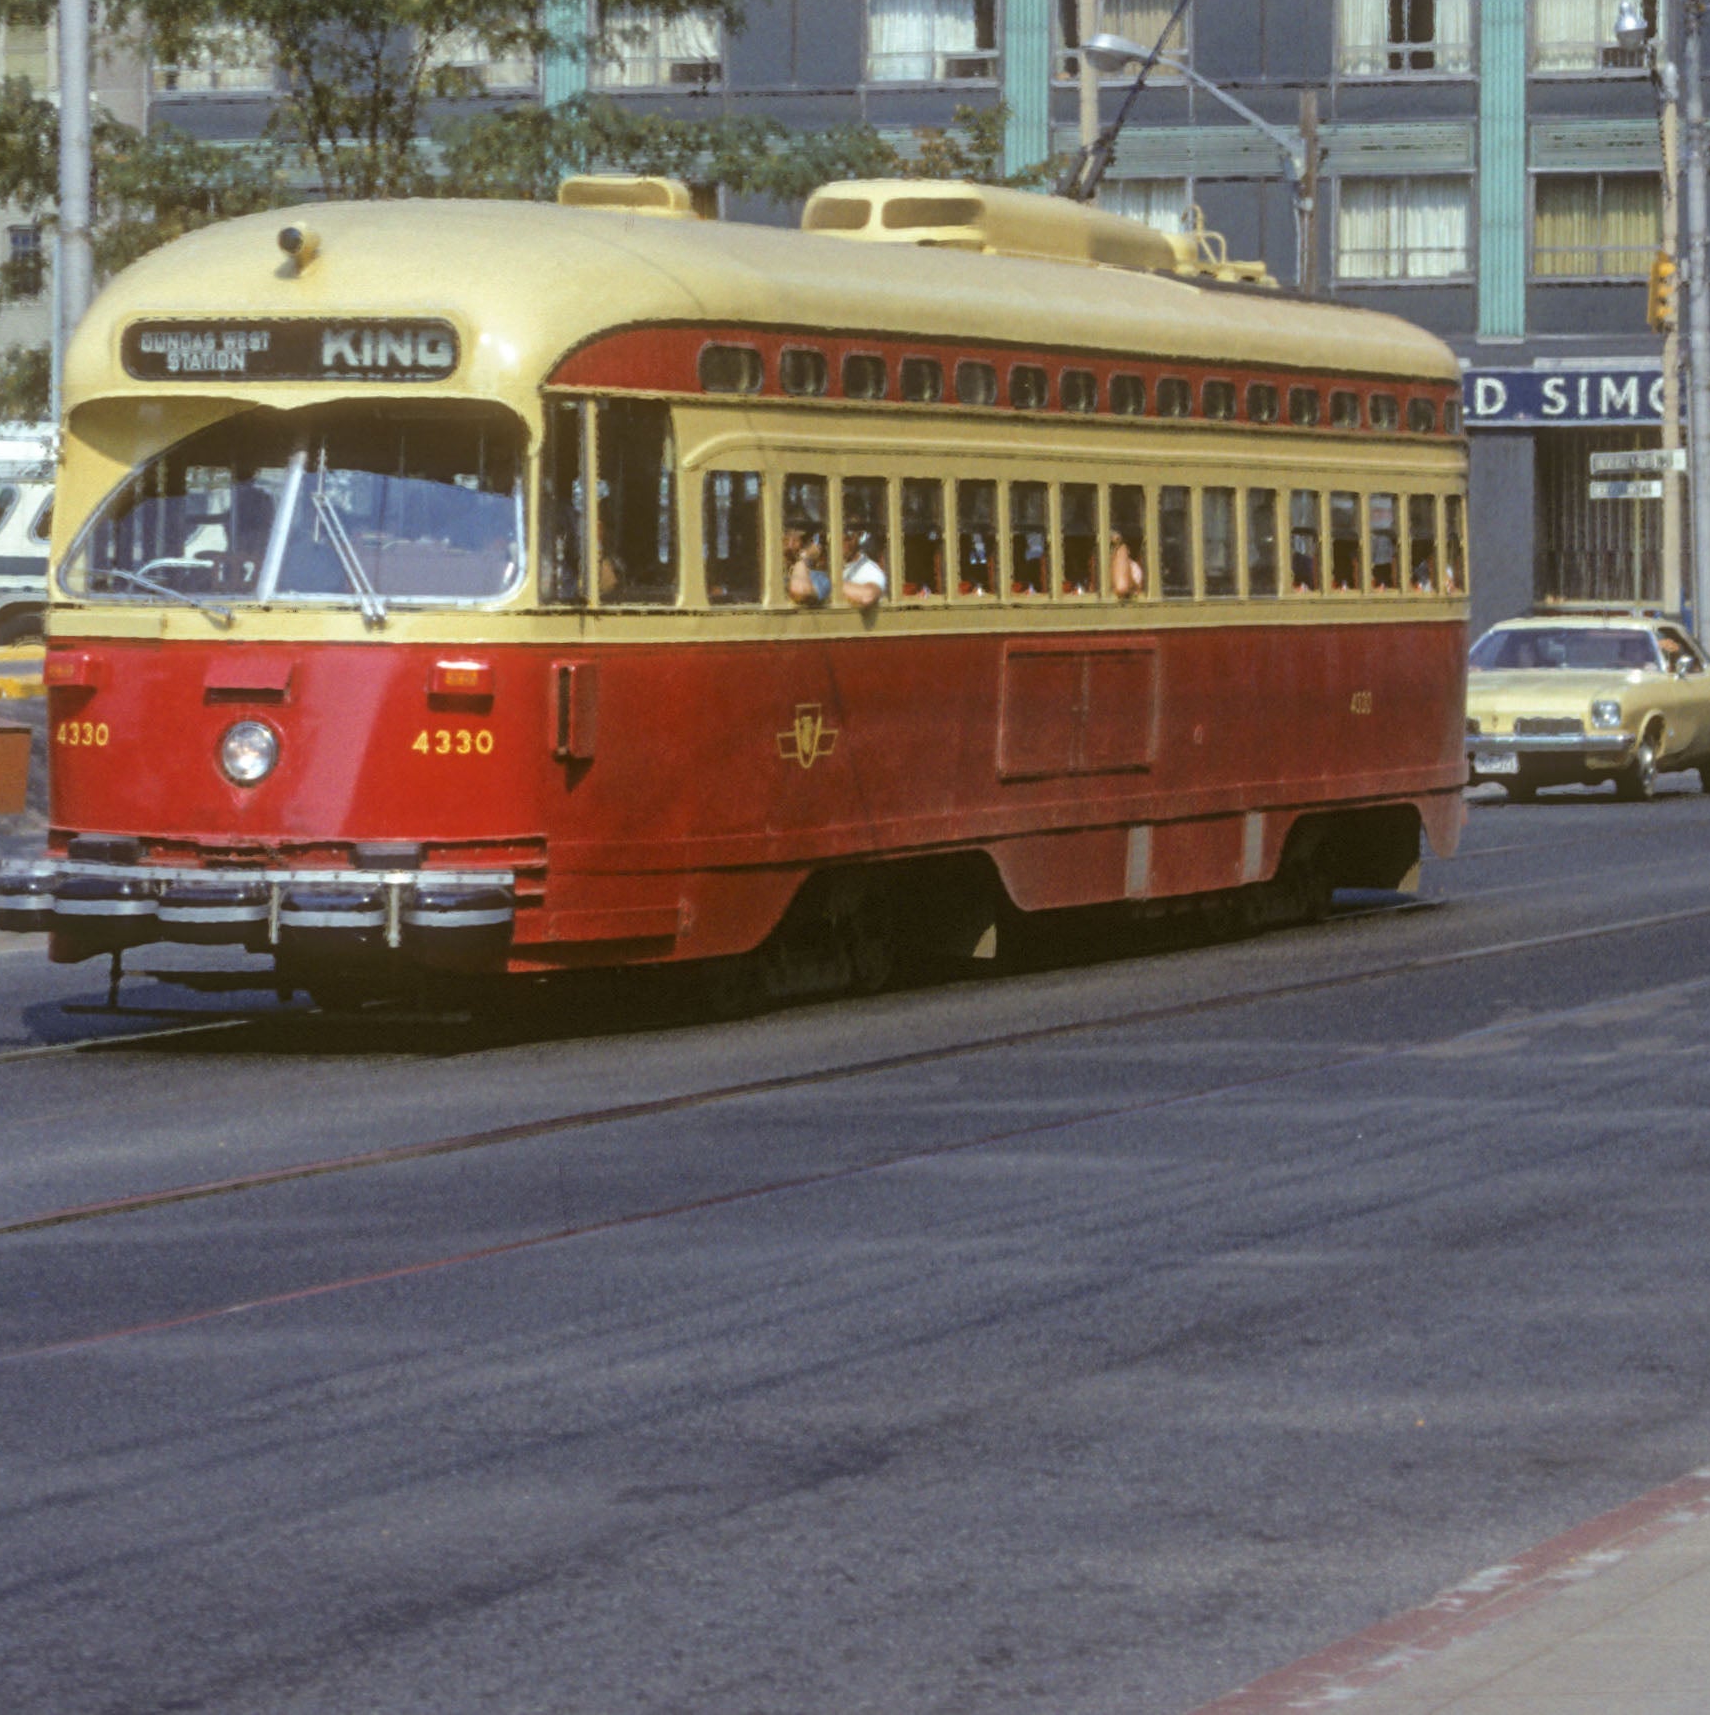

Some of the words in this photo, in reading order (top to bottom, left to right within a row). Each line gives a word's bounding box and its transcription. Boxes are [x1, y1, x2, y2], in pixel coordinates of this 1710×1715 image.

[141, 332, 215, 353] DUNDAS
[221, 332, 269, 352] WEST
[322, 329, 453, 367] KING
[167, 350, 245, 371] STATION
[56, 723, 109, 746] 4330
[412, 730, 494, 755] 4330
